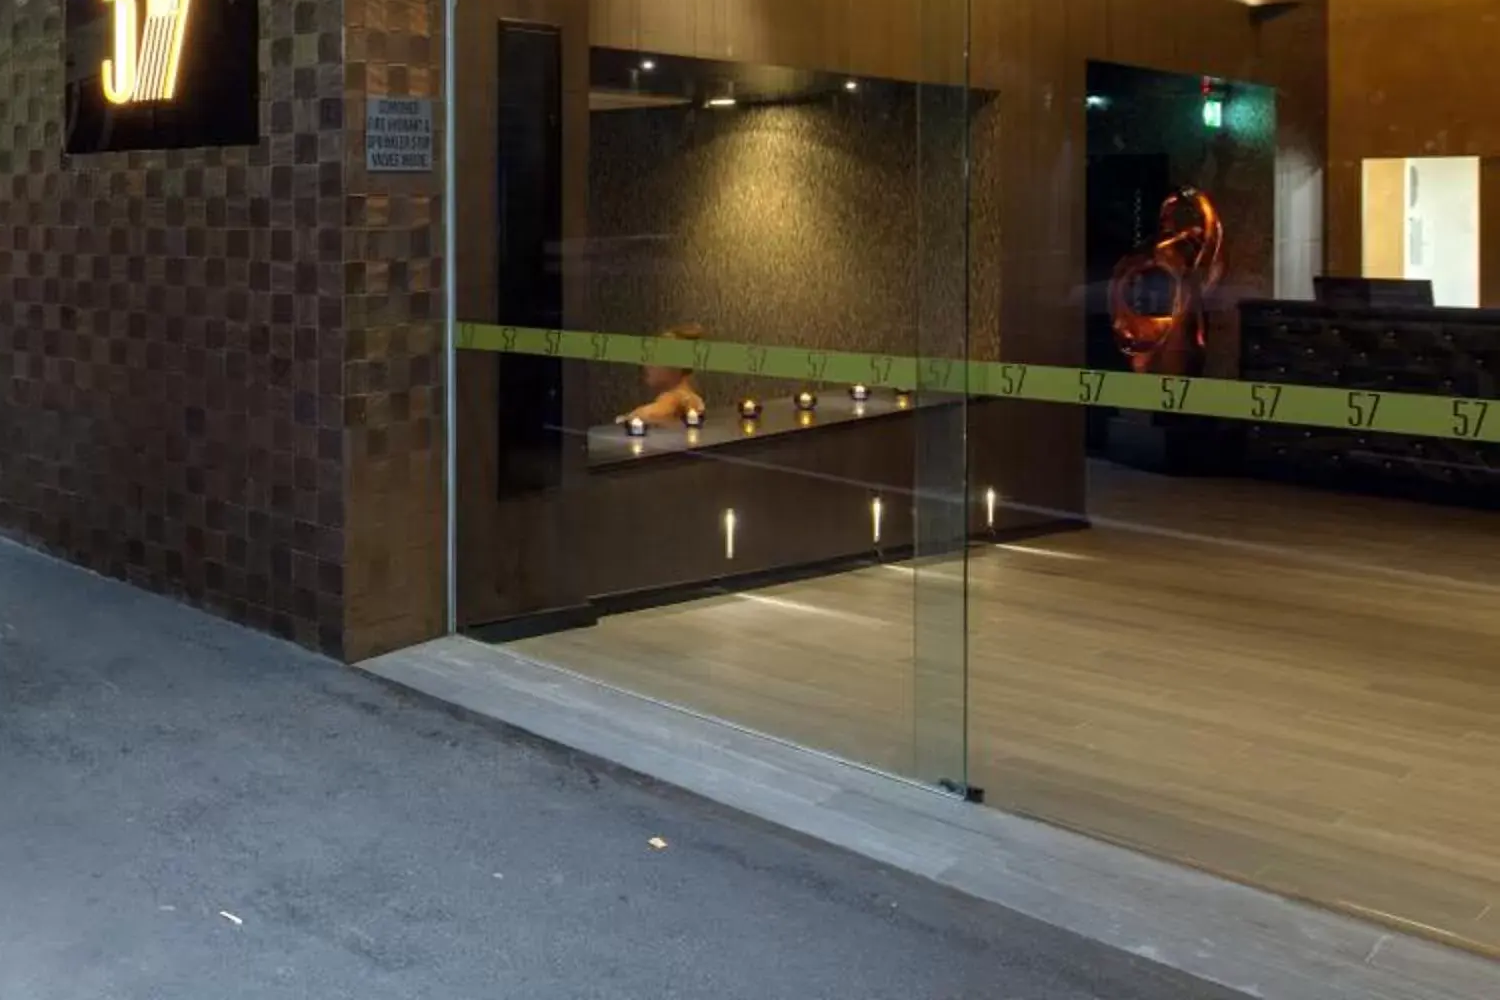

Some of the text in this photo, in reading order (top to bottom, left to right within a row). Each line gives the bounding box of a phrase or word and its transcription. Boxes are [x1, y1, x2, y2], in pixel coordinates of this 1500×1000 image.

[1001, 364, 1028, 395] 57
[1078, 370, 1106, 403] 57
[1160, 377, 1191, 411] 57
[1250, 384, 1283, 419] 57
[1347, 391, 1382, 428] 57
[1451, 399, 1489, 438] 57
